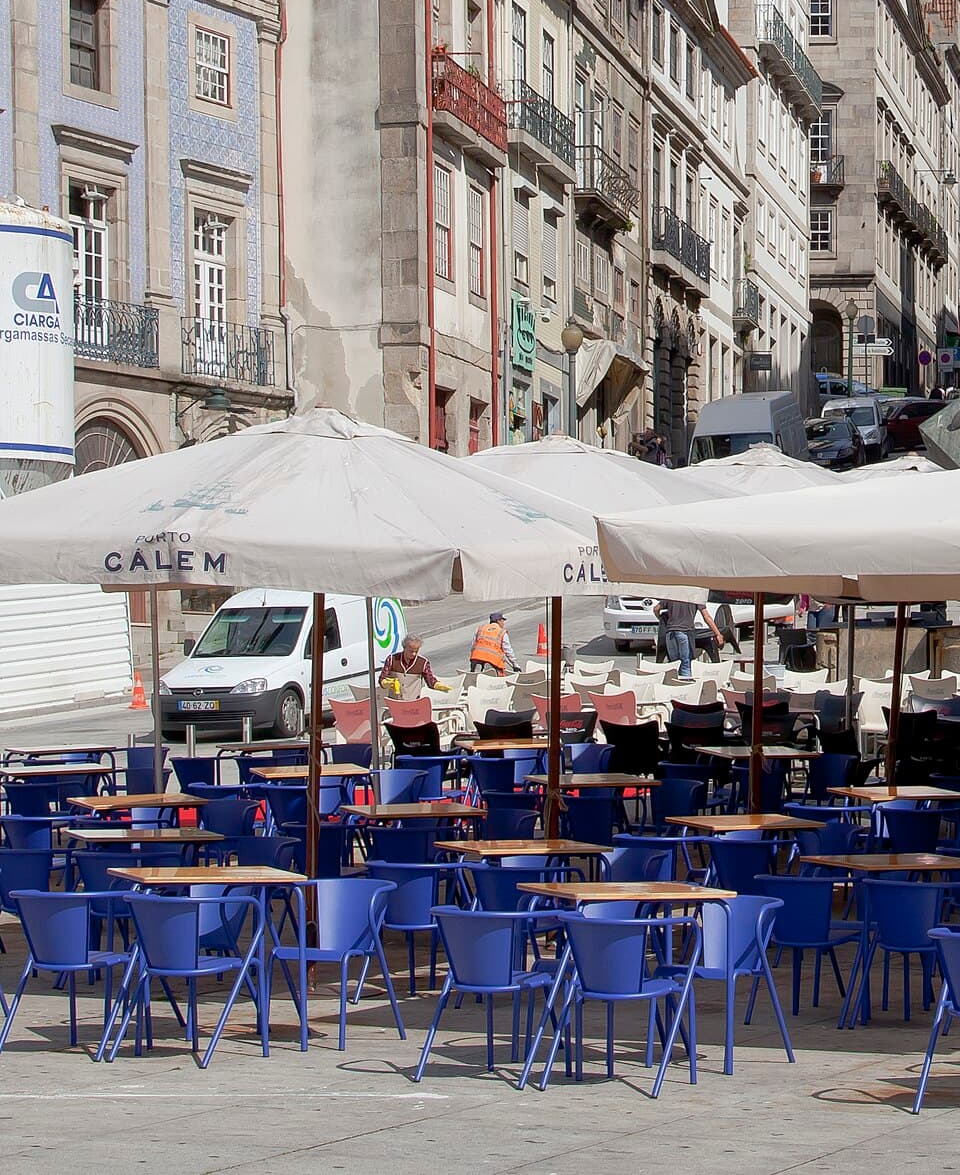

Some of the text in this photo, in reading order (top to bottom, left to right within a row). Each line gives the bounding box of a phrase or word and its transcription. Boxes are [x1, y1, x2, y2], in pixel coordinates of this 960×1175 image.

[13, 313, 61, 329] CIARGA
[0, 329, 59, 343] rgamassas
[135, 532, 191, 543] PORTO
[578, 546, 599, 556] POR
[104, 548, 226, 573] CÁLEM
